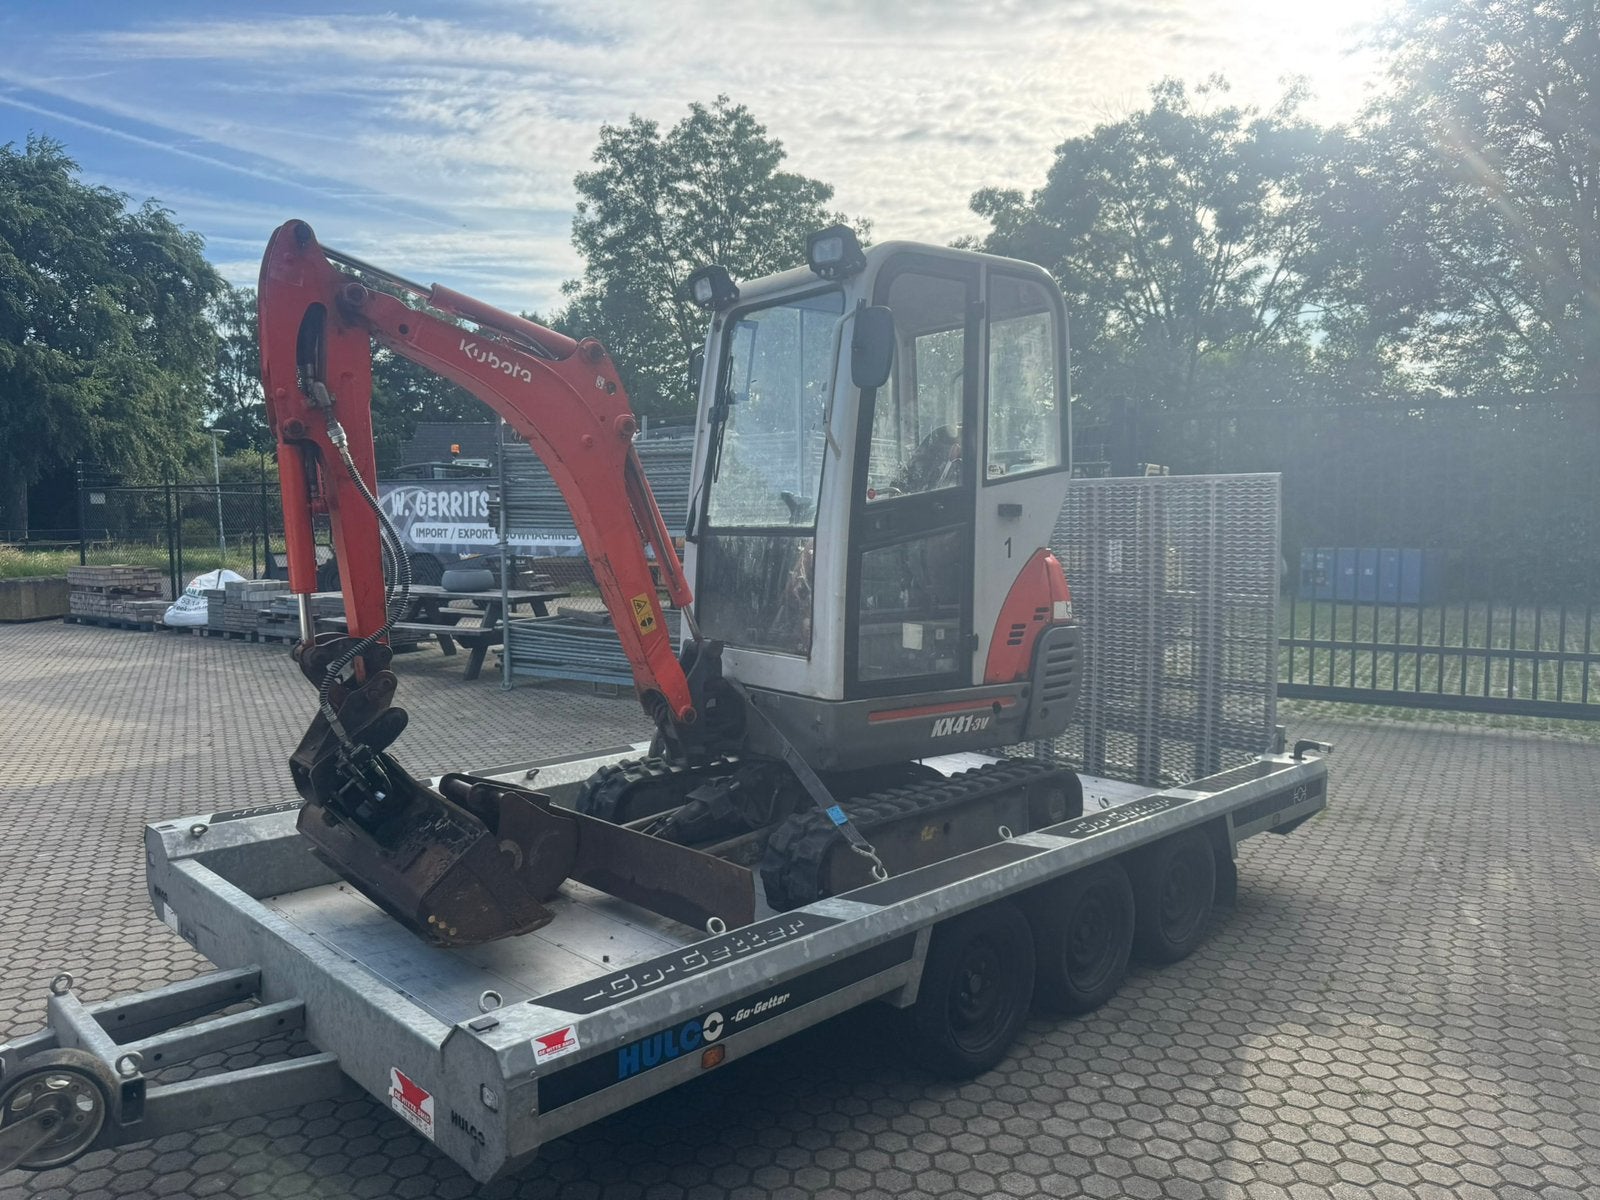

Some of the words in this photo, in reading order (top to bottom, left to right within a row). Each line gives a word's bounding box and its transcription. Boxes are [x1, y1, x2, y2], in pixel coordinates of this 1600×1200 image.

[459, 338, 532, 384] Kubota
[391, 491, 410, 517] W.
[415, 490, 490, 517] GERRITS
[415, 527, 448, 539] IMPORT
[450, 528, 456, 540] /
[458, 528, 495, 540] EXPORT
[1004, 536, 1012, 559] 1
[930, 714, 990, 738] KX41-3V
[617, 1011, 725, 1080] HULCO
[451, 1109, 485, 1146] HULCO
